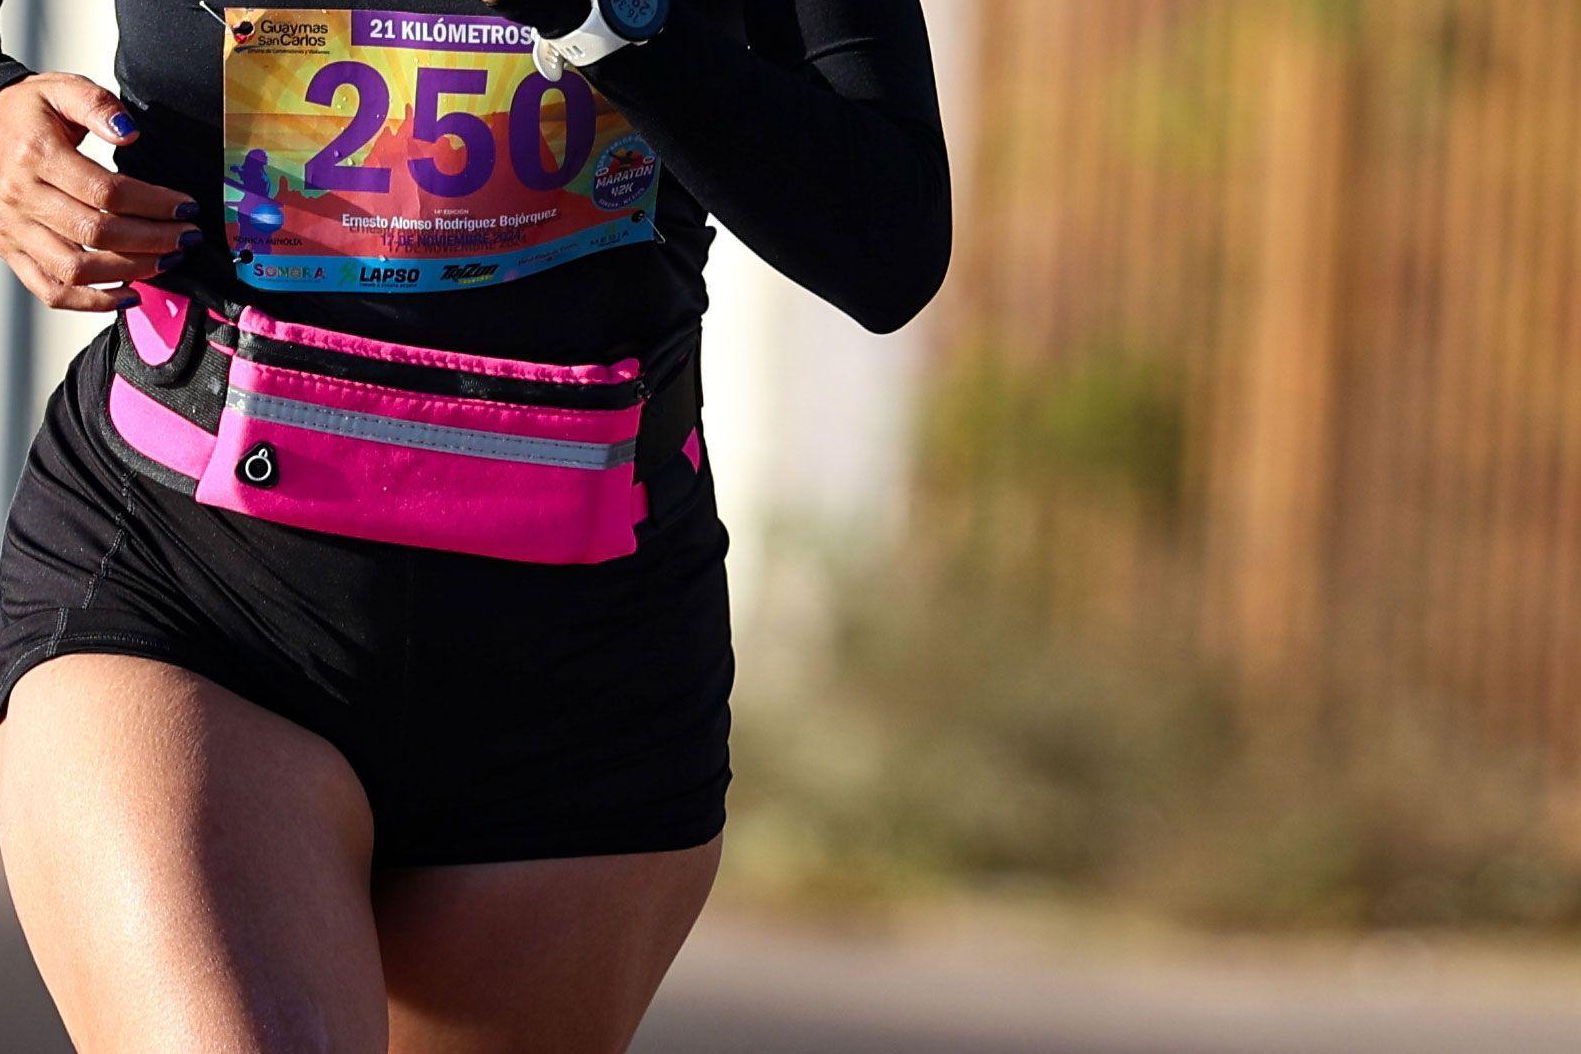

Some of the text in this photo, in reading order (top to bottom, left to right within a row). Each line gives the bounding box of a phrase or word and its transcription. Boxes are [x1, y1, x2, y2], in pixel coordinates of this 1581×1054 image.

[261, 20, 328, 36] Guaymas
[369, 17, 534, 45] 21 KILÓMETROS
[304, 60, 597, 198] 250
[342, 213, 388, 229] Ernesto
[390, 216, 432, 230] Alonso
[499, 208, 558, 227] Bojórquez
[360, 267, 420, 283] LAPSO
